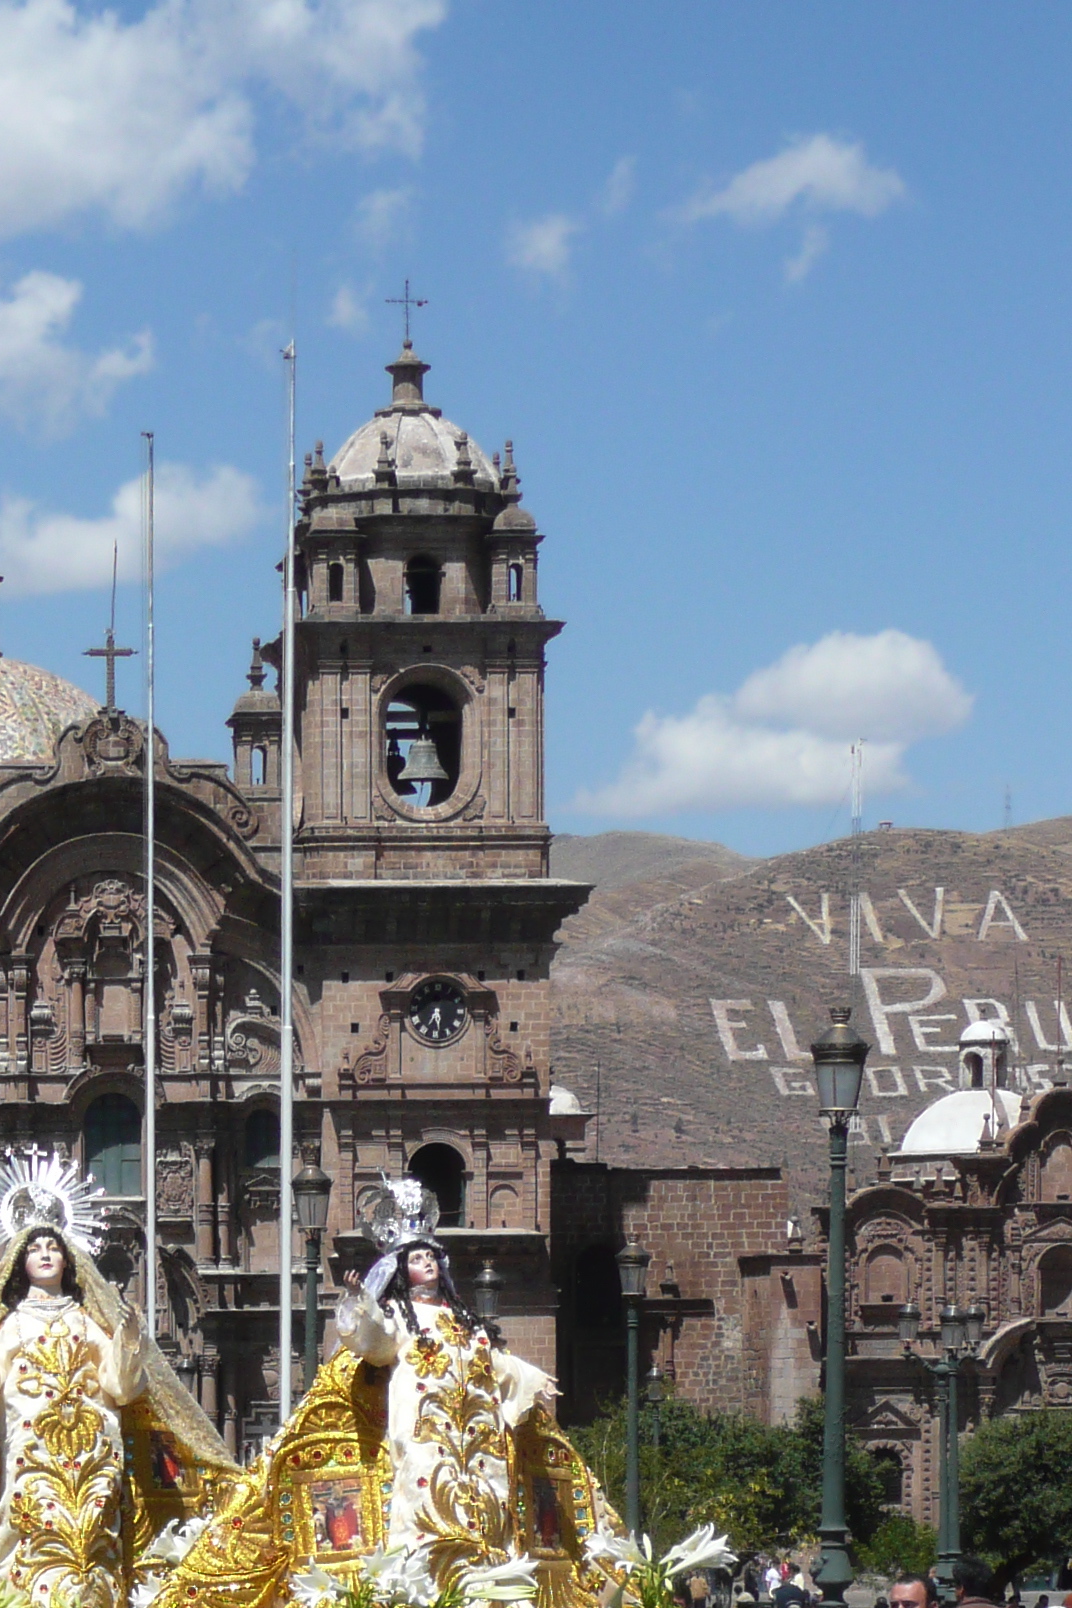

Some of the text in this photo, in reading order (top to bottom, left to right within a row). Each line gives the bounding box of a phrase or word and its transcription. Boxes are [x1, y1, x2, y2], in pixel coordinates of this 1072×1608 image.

[787, 886, 1029, 943] VIVA
[709, 967, 1072, 1060] EL PERU
